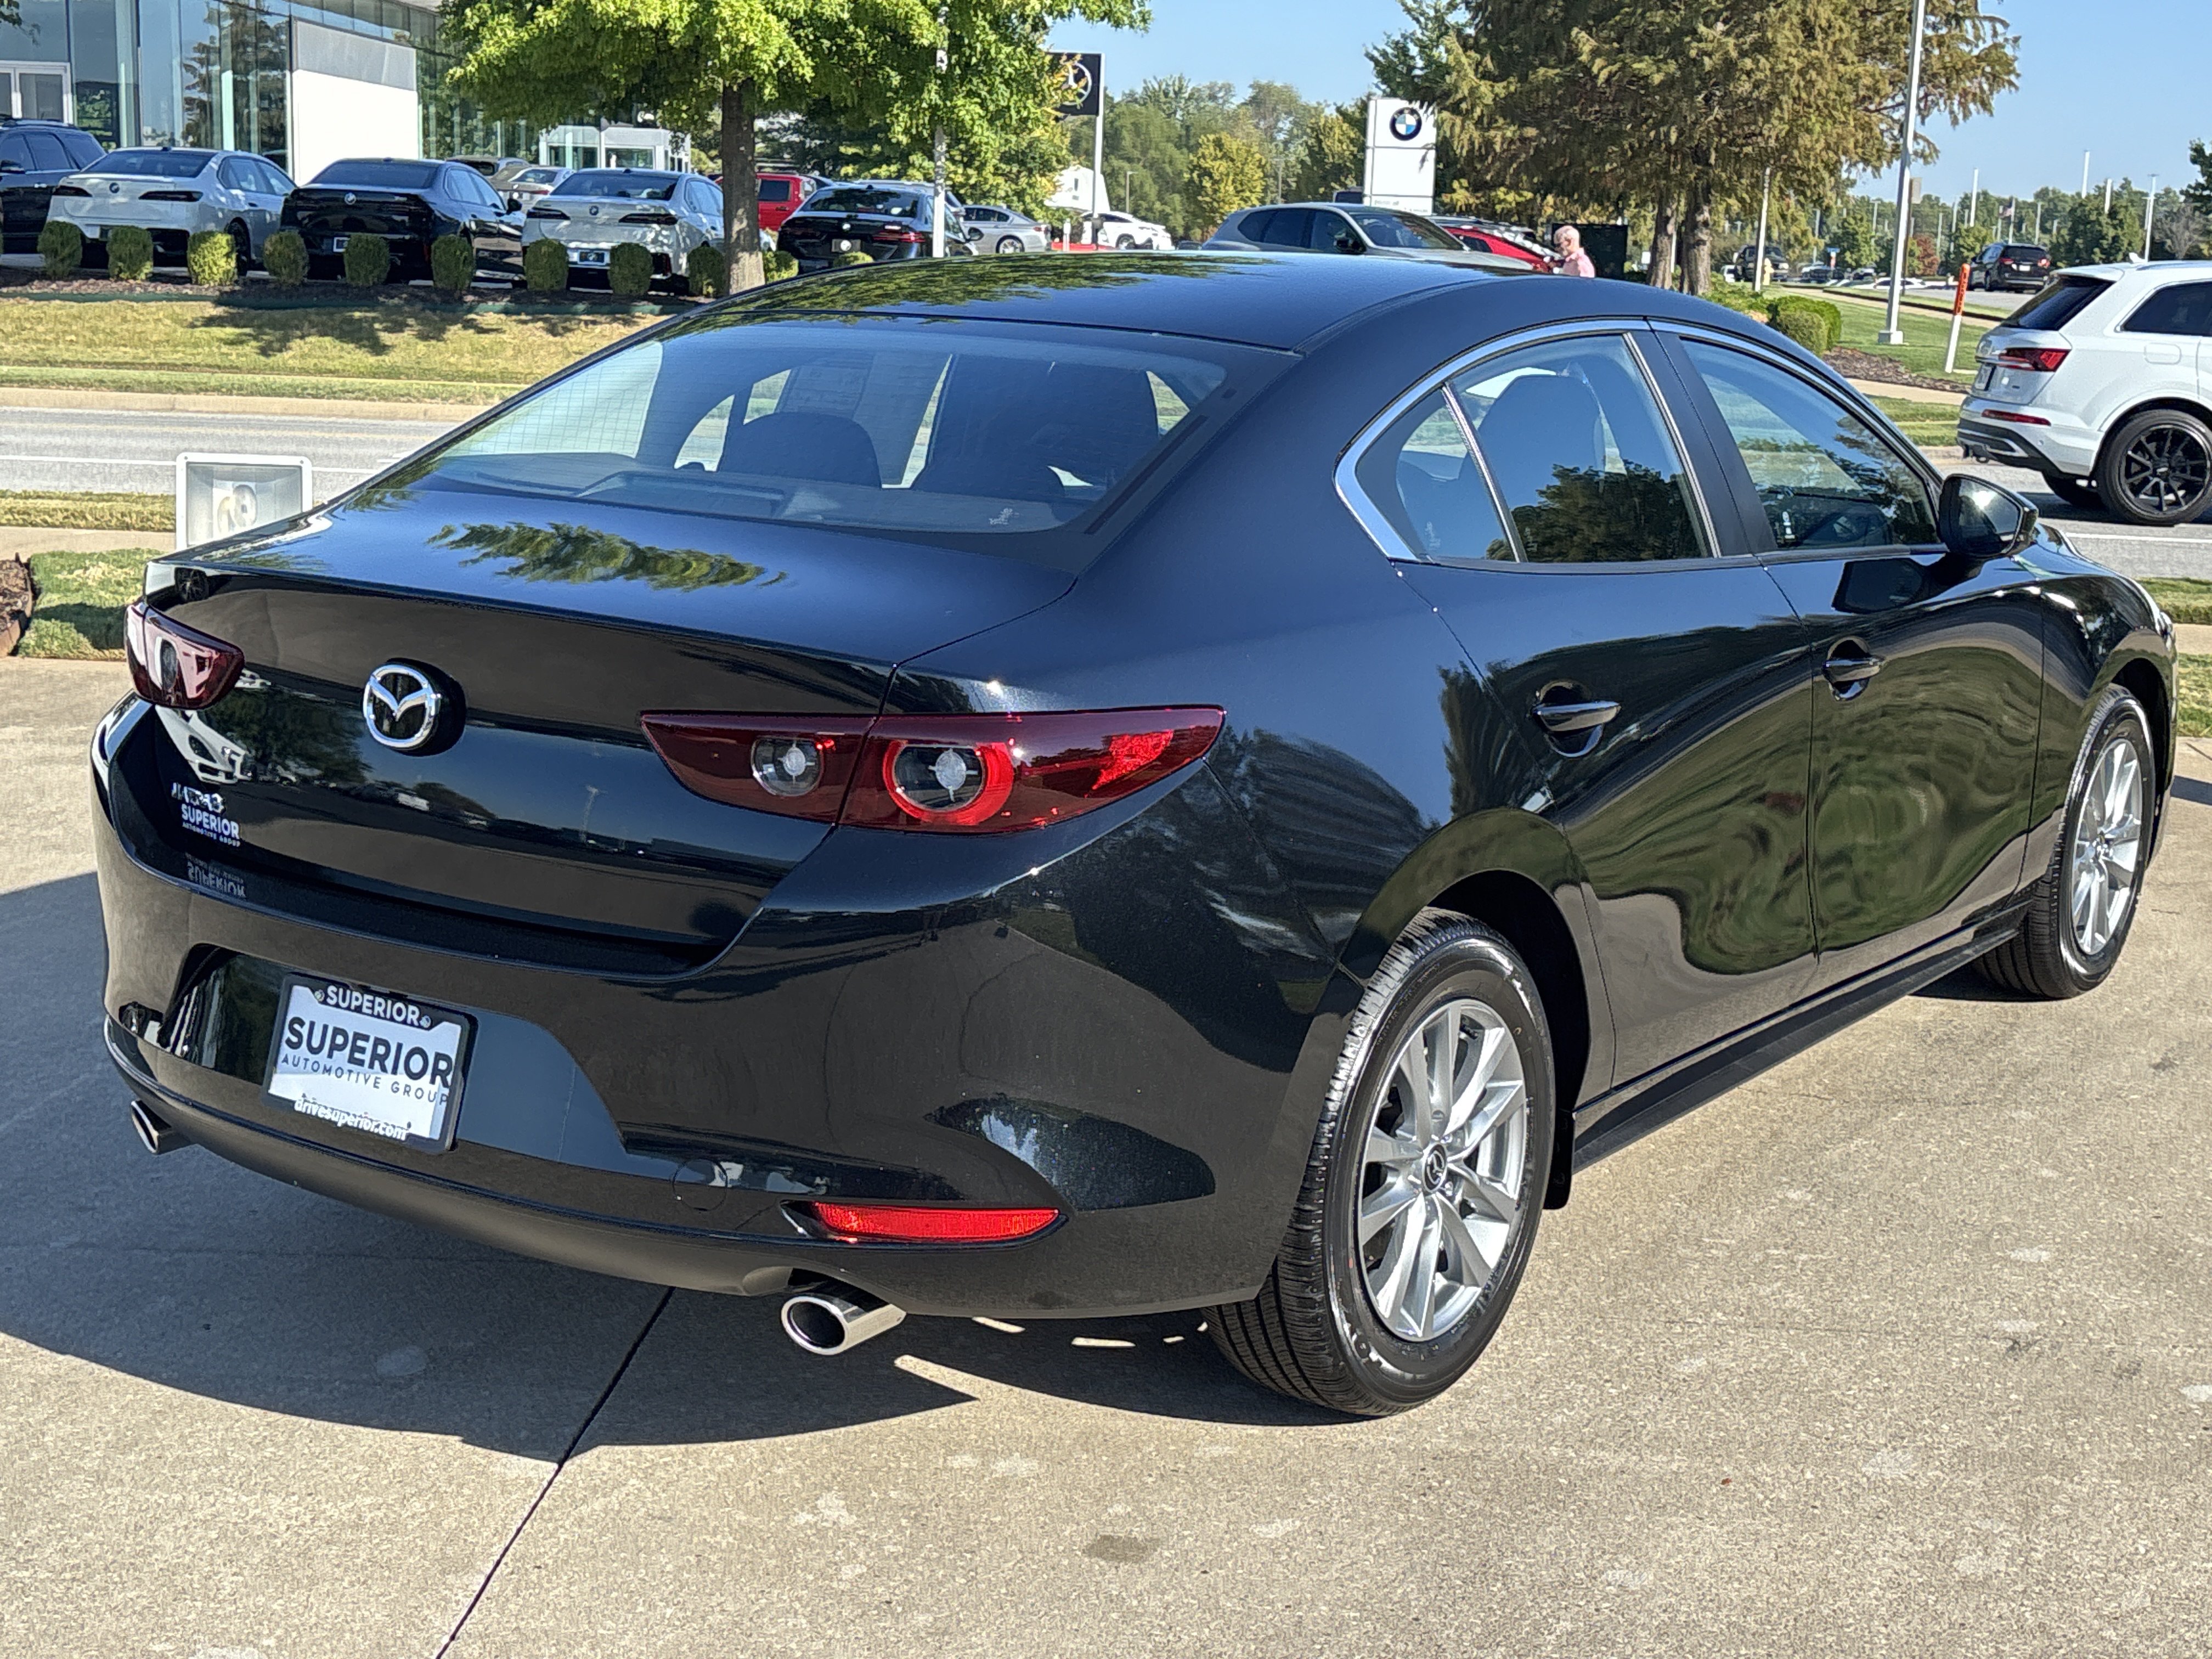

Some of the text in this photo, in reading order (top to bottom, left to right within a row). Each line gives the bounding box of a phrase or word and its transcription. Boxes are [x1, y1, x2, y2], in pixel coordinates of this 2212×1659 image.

[181, 803, 240, 839] SUPERIOR
[326, 985, 420, 1028] SUPERIOR
[285, 1017, 453, 1088] SUPERIOR
[281, 1053, 448, 1106] AUTOMOTIVE GROUP
[294, 1097, 408, 1141] drivesuperior.com
